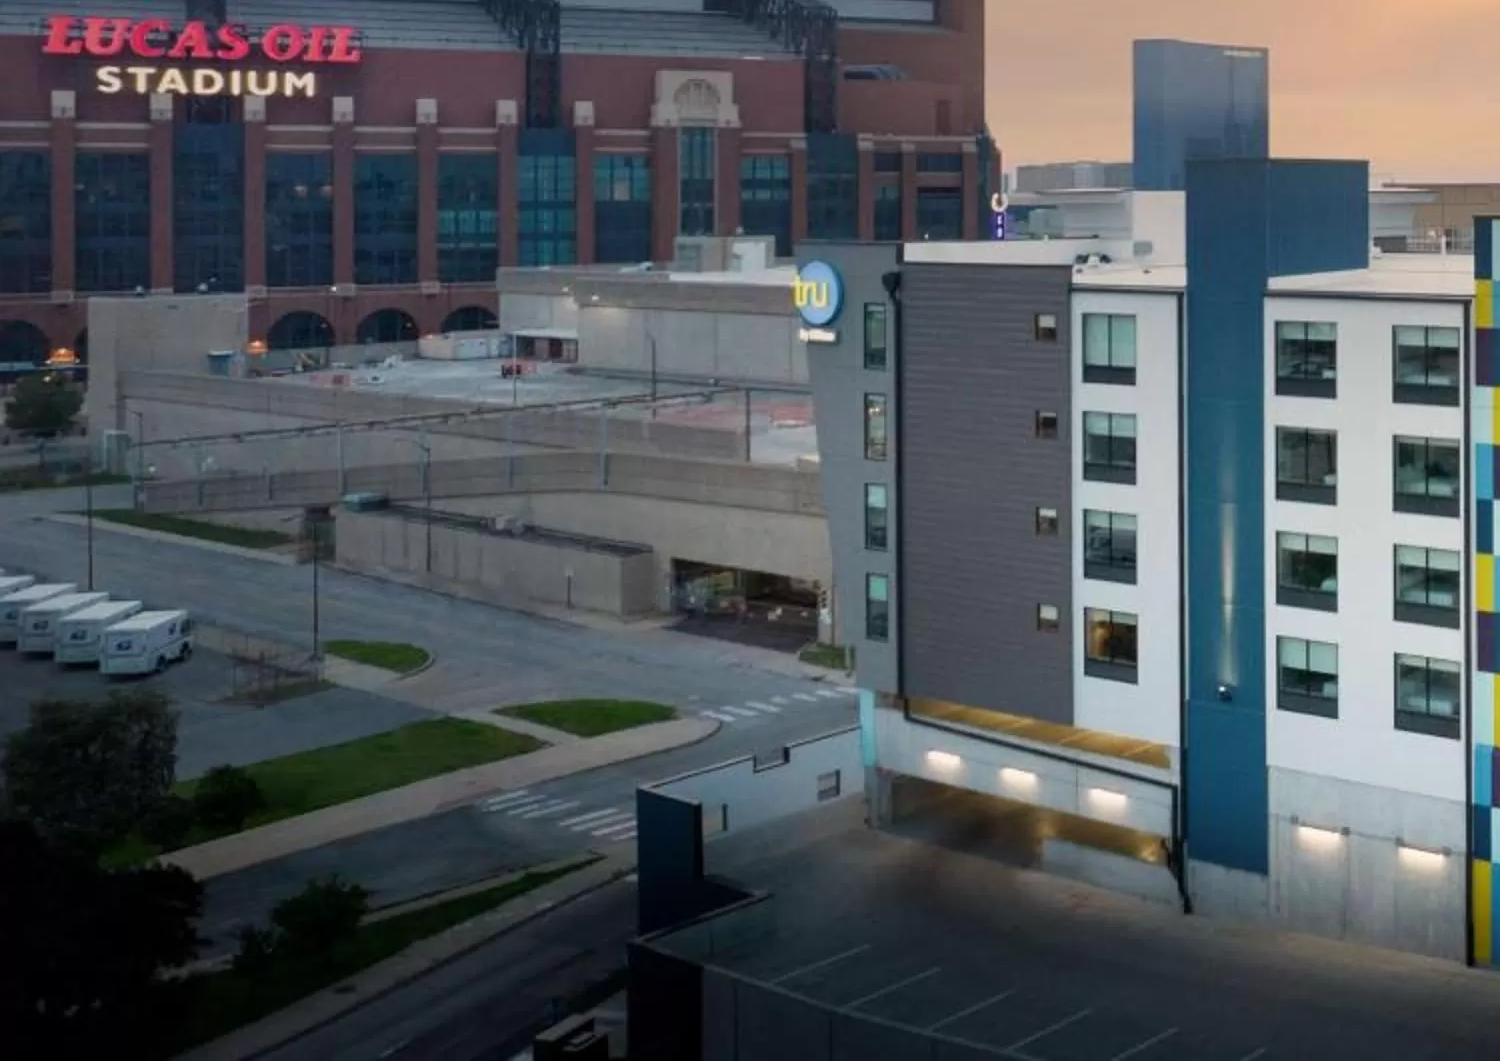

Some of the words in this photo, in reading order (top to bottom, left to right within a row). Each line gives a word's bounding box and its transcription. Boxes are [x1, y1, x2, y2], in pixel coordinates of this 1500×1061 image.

[42, 16, 250, 60] LUCAS
[261, 22, 361, 62] OIL
[96, 65, 315, 97] STADIUM
[792, 274, 829, 308] tru
